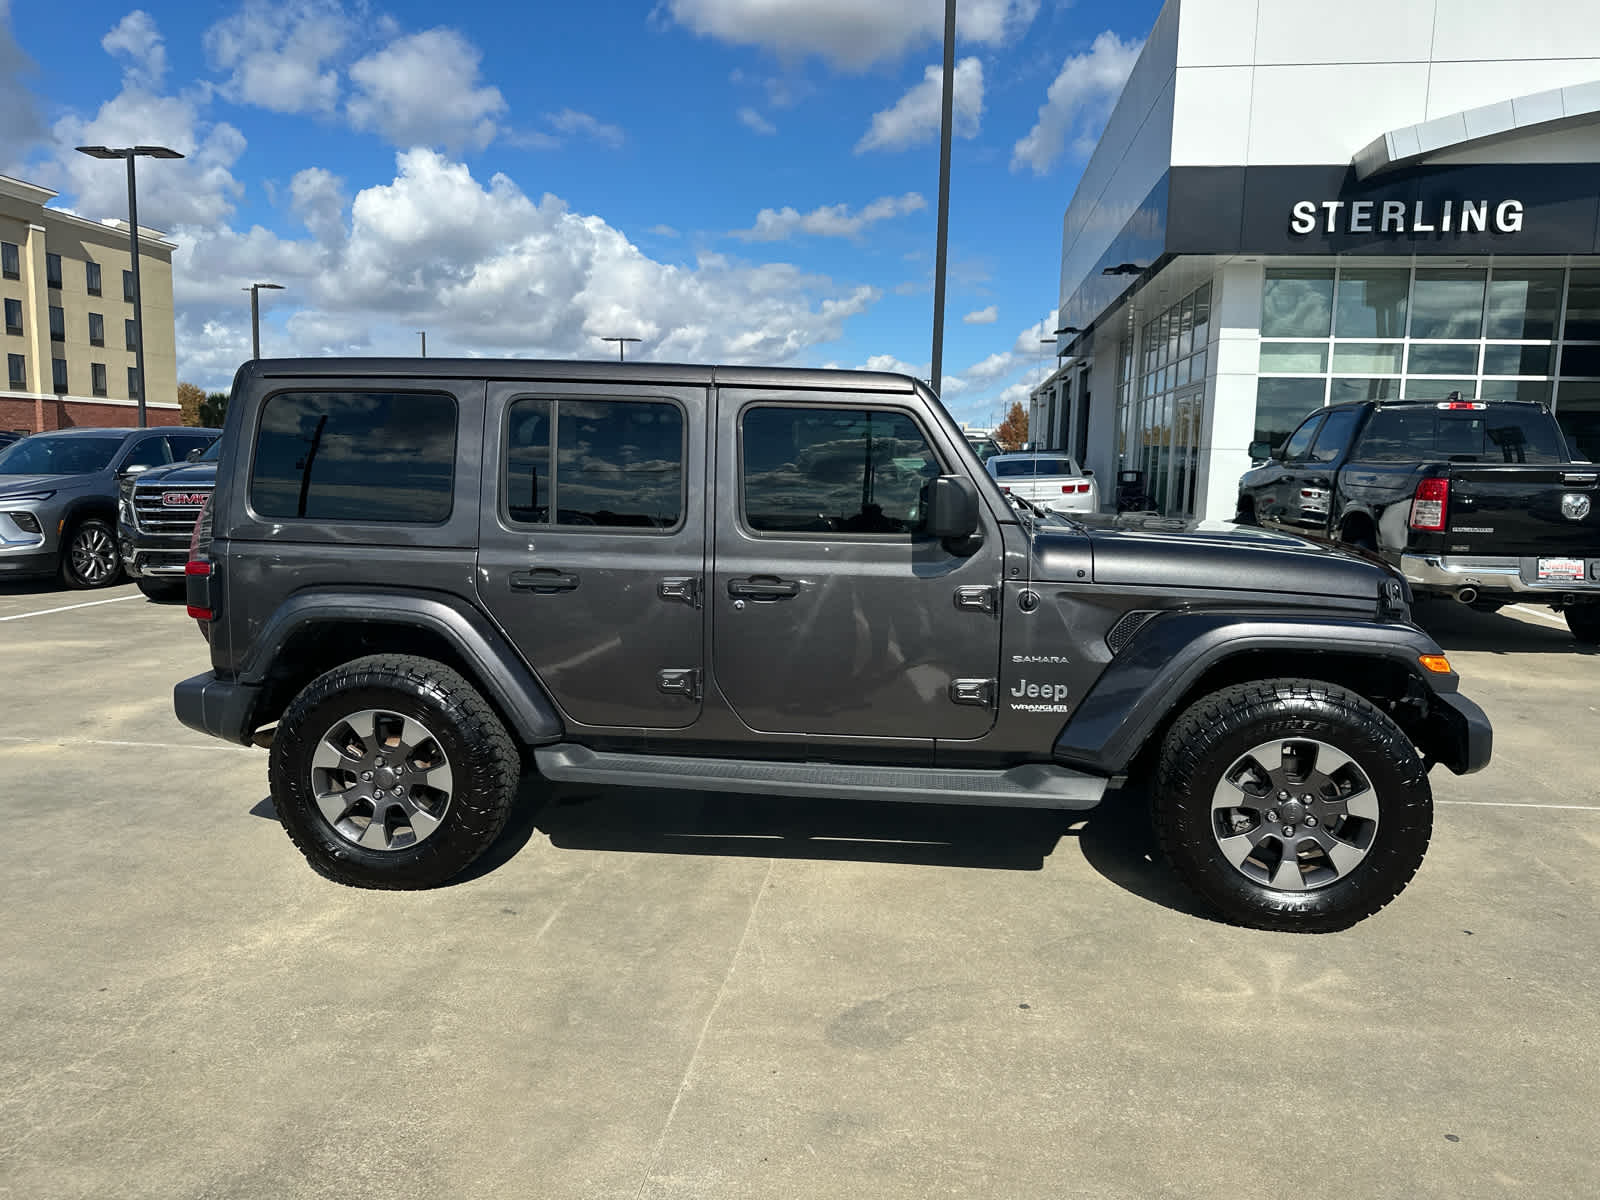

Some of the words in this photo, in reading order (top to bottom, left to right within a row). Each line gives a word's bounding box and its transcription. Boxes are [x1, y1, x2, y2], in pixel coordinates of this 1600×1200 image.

[1291, 200, 1524, 233] STERLING
[164, 493, 209, 504] GMC
[1012, 655, 1070, 663] SAHARA
[1010, 679, 1068, 702] Jeep
[1010, 703, 1068, 711] WRANGLER
